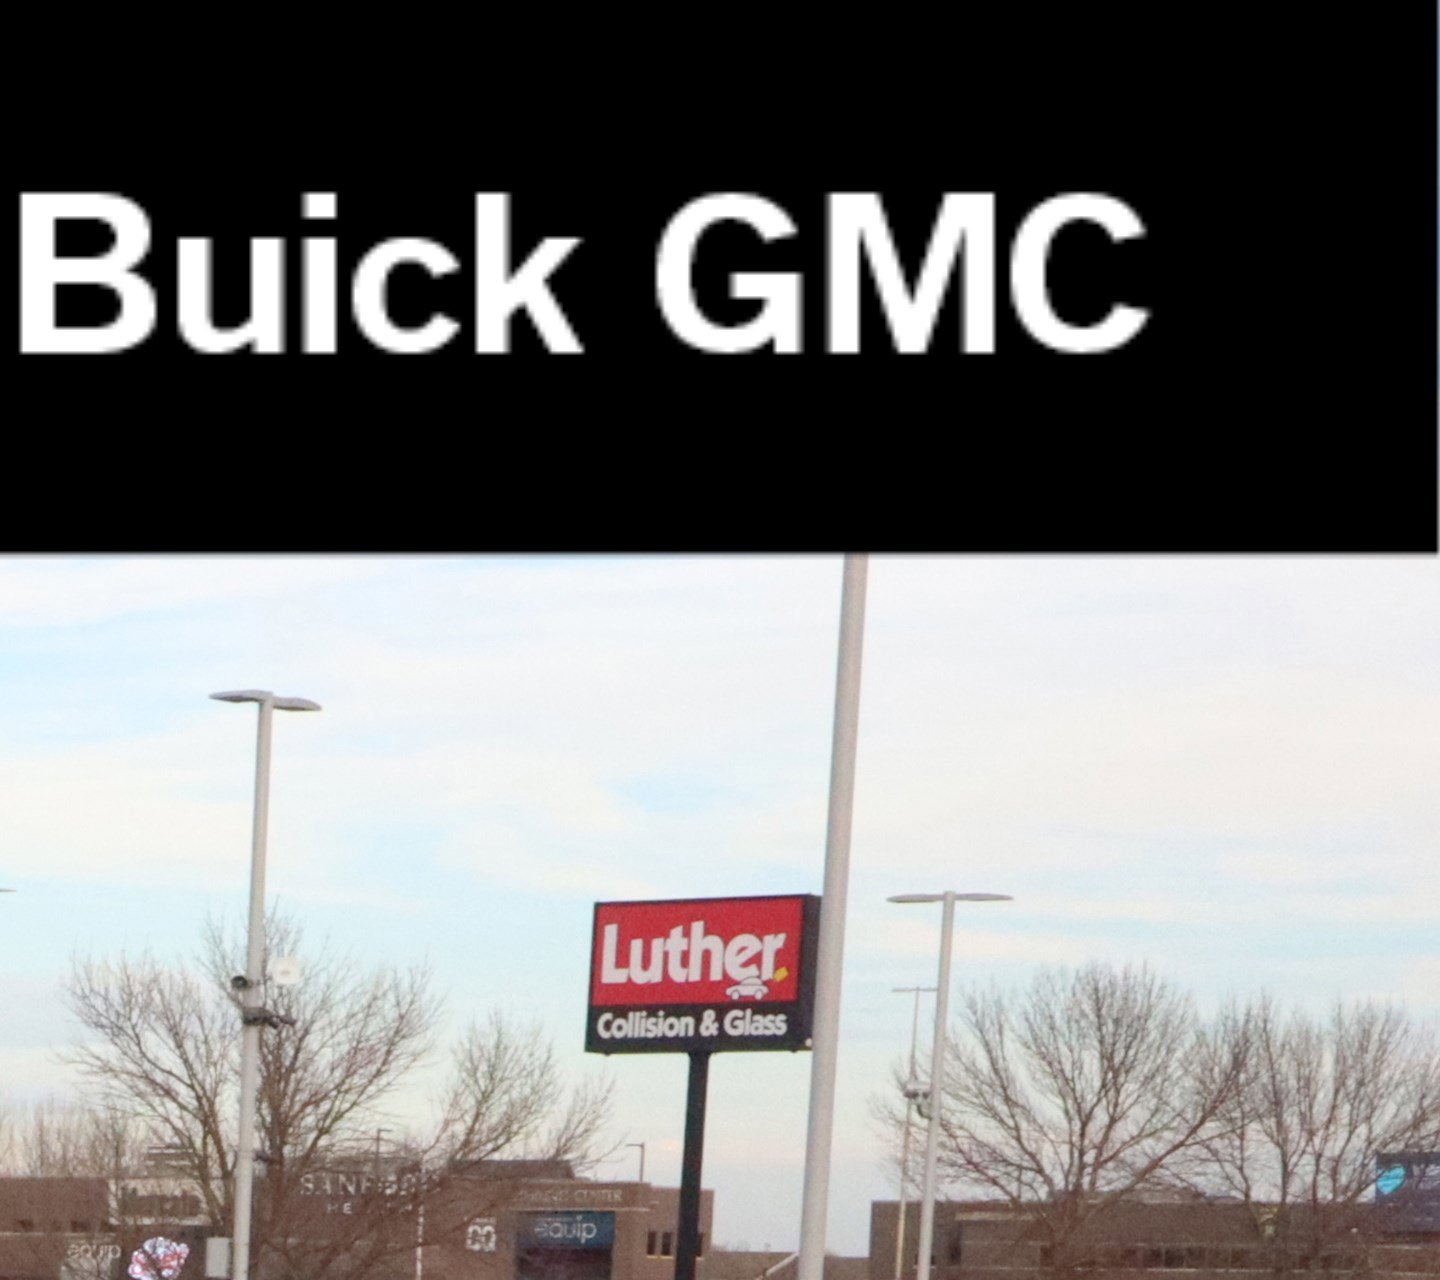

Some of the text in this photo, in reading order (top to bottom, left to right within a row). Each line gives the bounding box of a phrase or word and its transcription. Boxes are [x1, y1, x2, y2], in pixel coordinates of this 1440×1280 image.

[601, 920, 787, 985] Luther
[597, 1008, 788, 1040] Collision & Glass
